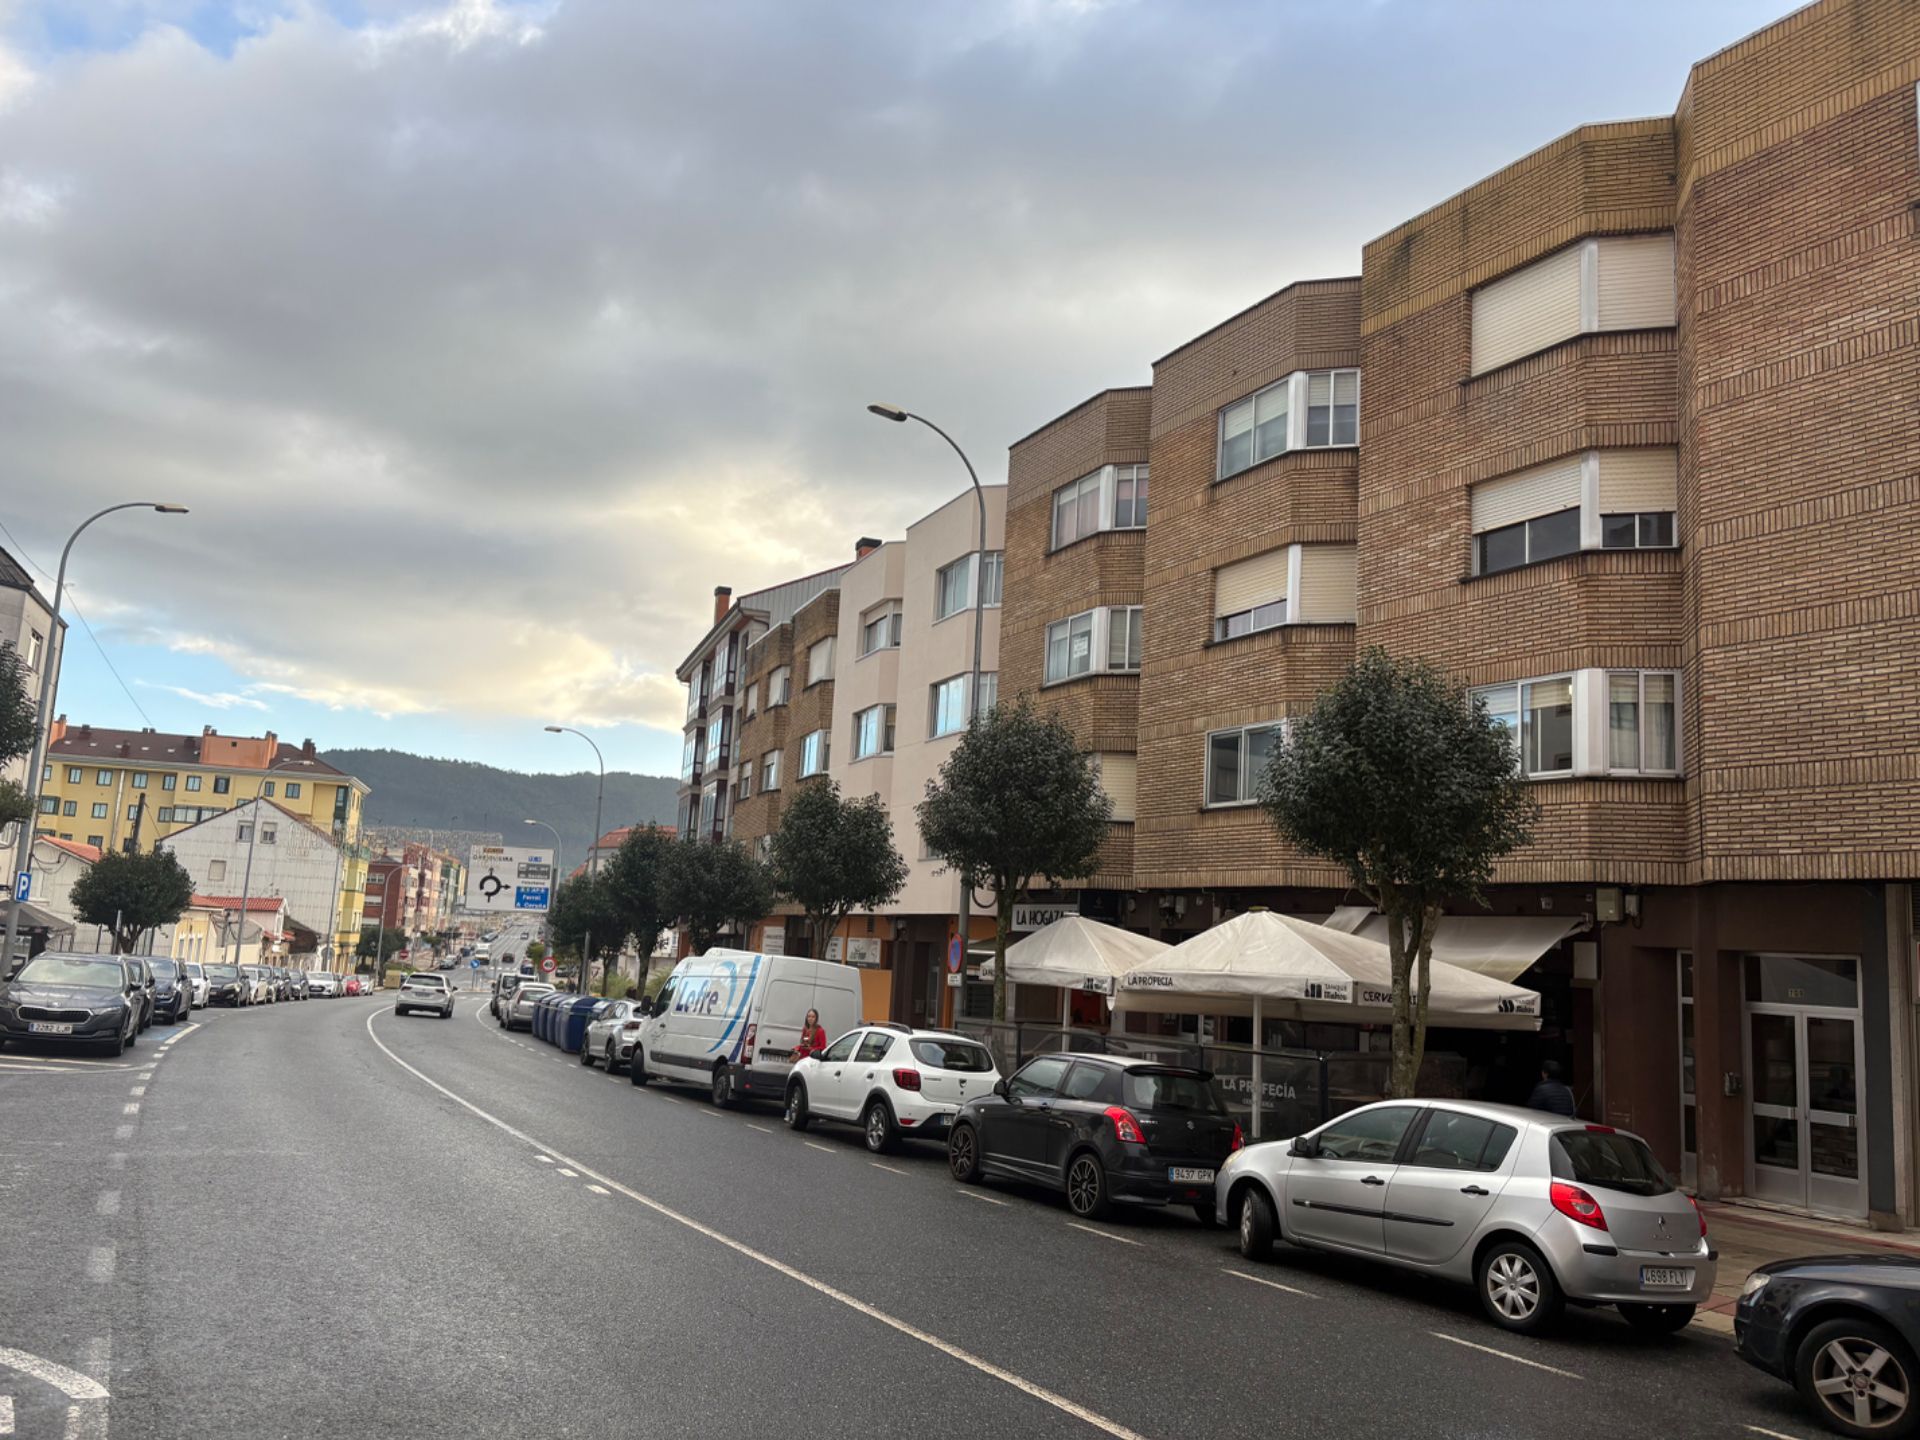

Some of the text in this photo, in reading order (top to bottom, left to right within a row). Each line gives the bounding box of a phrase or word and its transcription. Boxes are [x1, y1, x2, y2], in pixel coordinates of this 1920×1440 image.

[18, 875, 29, 899] P
[1016, 910, 1027, 926] LA
[1127, 976, 1138, 986] LA
[1222, 1079, 1297, 1099] LA PRFECÍA
